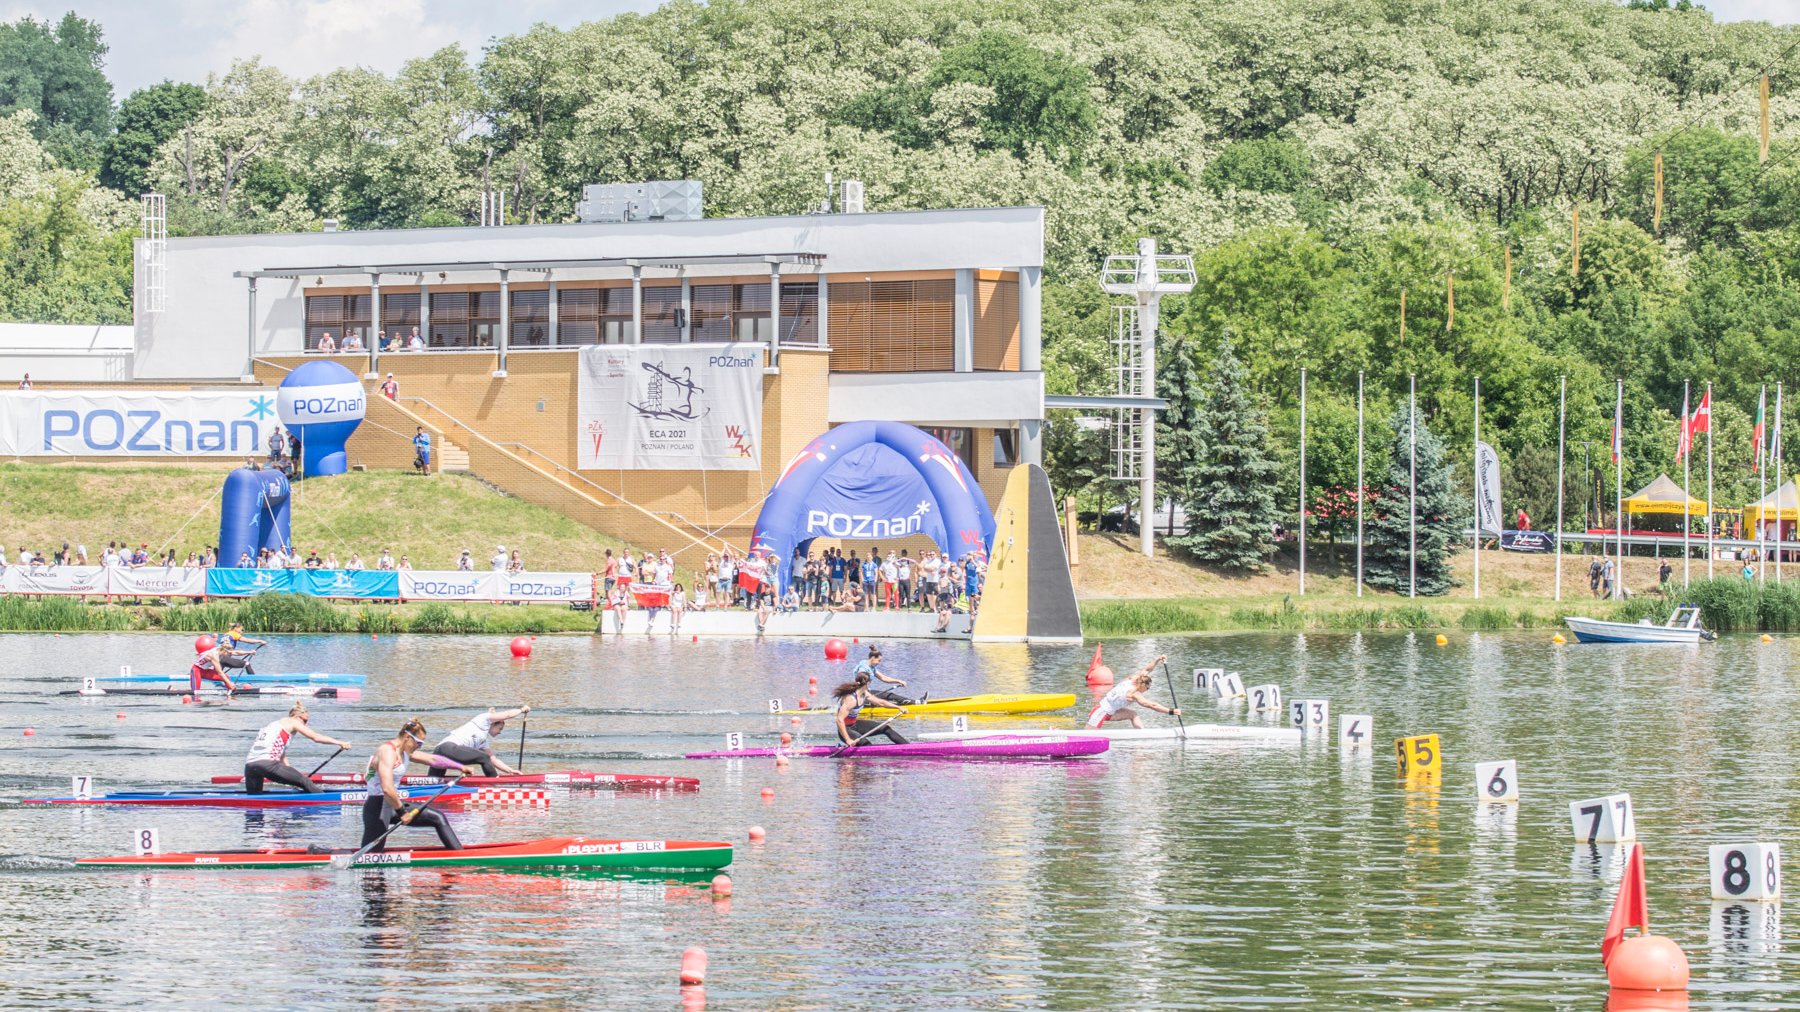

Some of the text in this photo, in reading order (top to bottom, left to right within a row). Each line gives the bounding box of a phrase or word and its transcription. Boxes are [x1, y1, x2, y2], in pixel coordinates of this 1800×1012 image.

[649, 430, 686, 438] ECA 2021
[136, 579, 179, 588] Mercure
[123, 667, 128, 675] 1
[87, 678, 93, 689] 2
[1227, 678, 1236, 694] 1
[772, 699, 779, 711] 3
[1254, 689, 1266, 708] 2
[1271, 688, 1278, 706] 2
[956, 716, 963, 728] 4
[1294, 703, 1304, 725] 3
[1312, 703, 1323, 724] 3
[731, 733, 739, 747] 5
[1346, 720, 1364, 743] 4
[1397, 741, 1406, 769] 5
[1415, 738, 1433, 766] 5
[77, 776, 87, 793] 7
[1487, 766, 1507, 798] 6
[1580, 804, 1603, 842] 7
[1615, 800, 1627, 837] 7
[141, 830, 152, 849] 8
[636, 841, 662, 851] BLR
[1723, 850, 1751, 895] 8
[1766, 850, 1776, 894] 8
